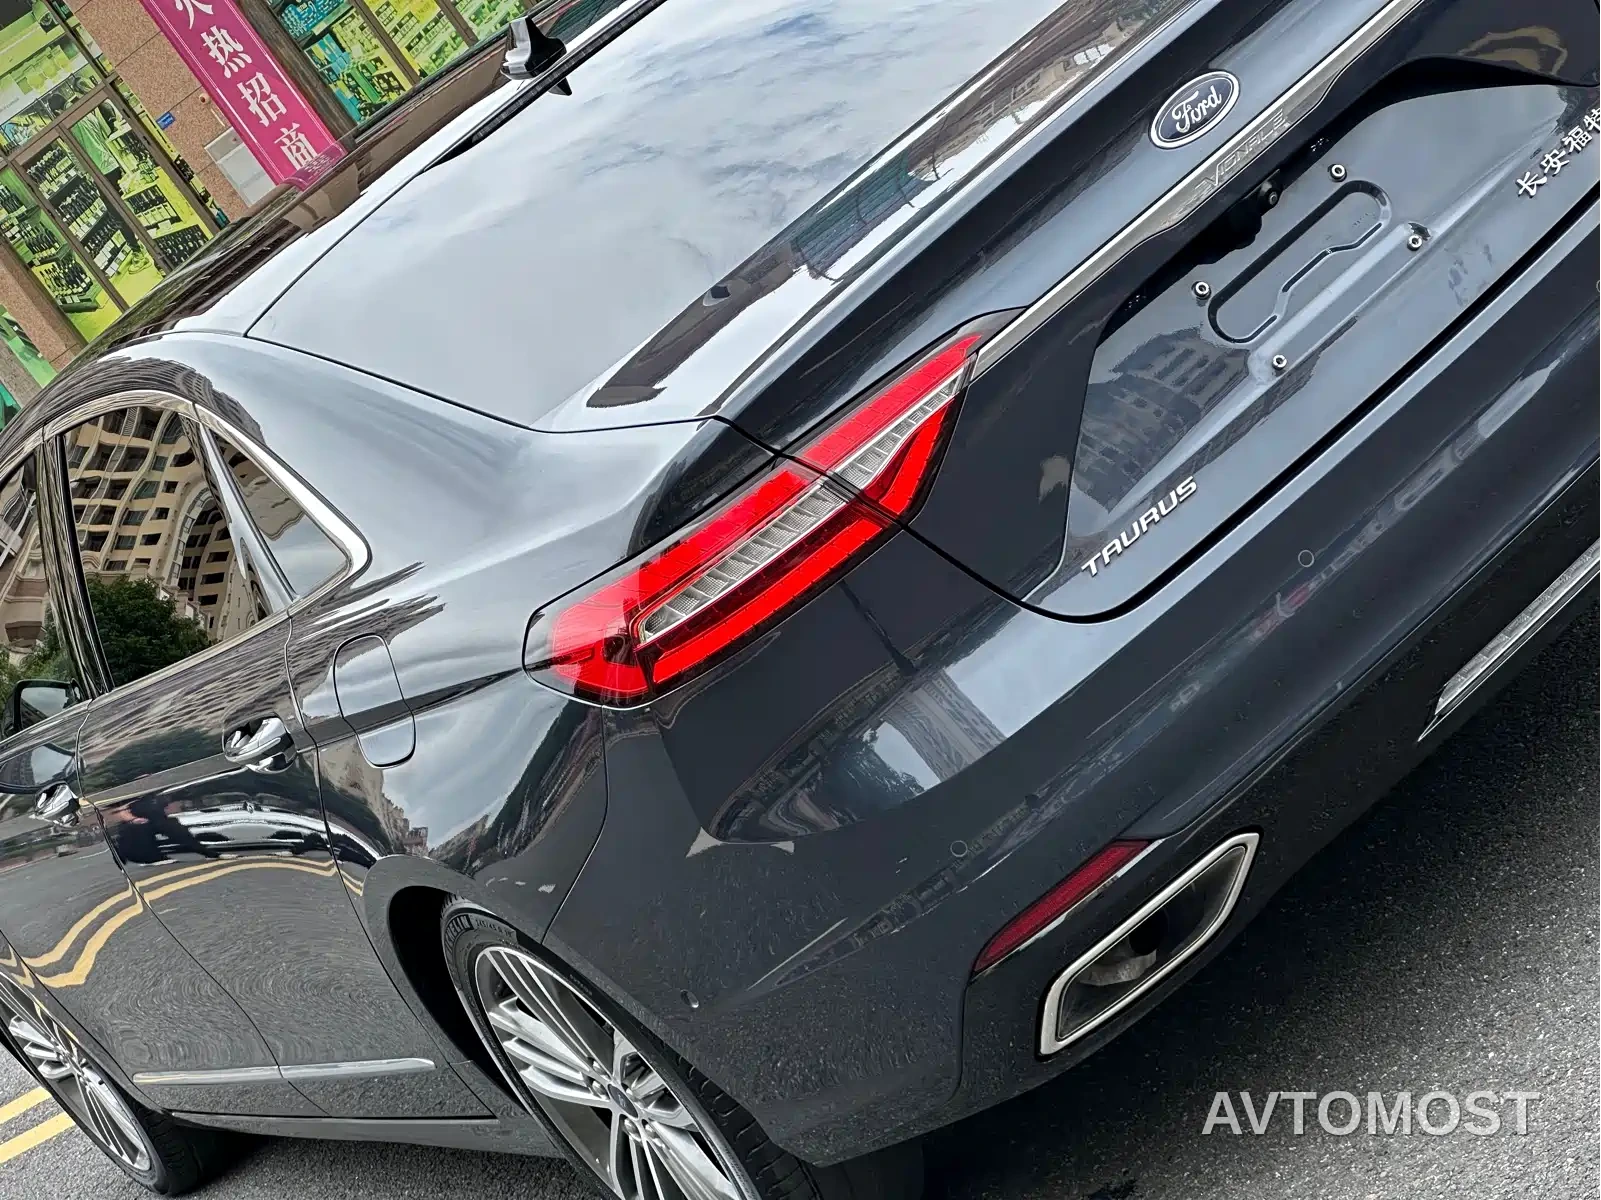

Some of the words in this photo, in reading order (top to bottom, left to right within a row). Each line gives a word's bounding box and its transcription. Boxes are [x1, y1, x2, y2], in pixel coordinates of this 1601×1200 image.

[1171, 85, 1222, 133] Ford
[1195, 108, 1286, 188] VIGNALE
[1081, 475, 1197, 576] TAURUS
